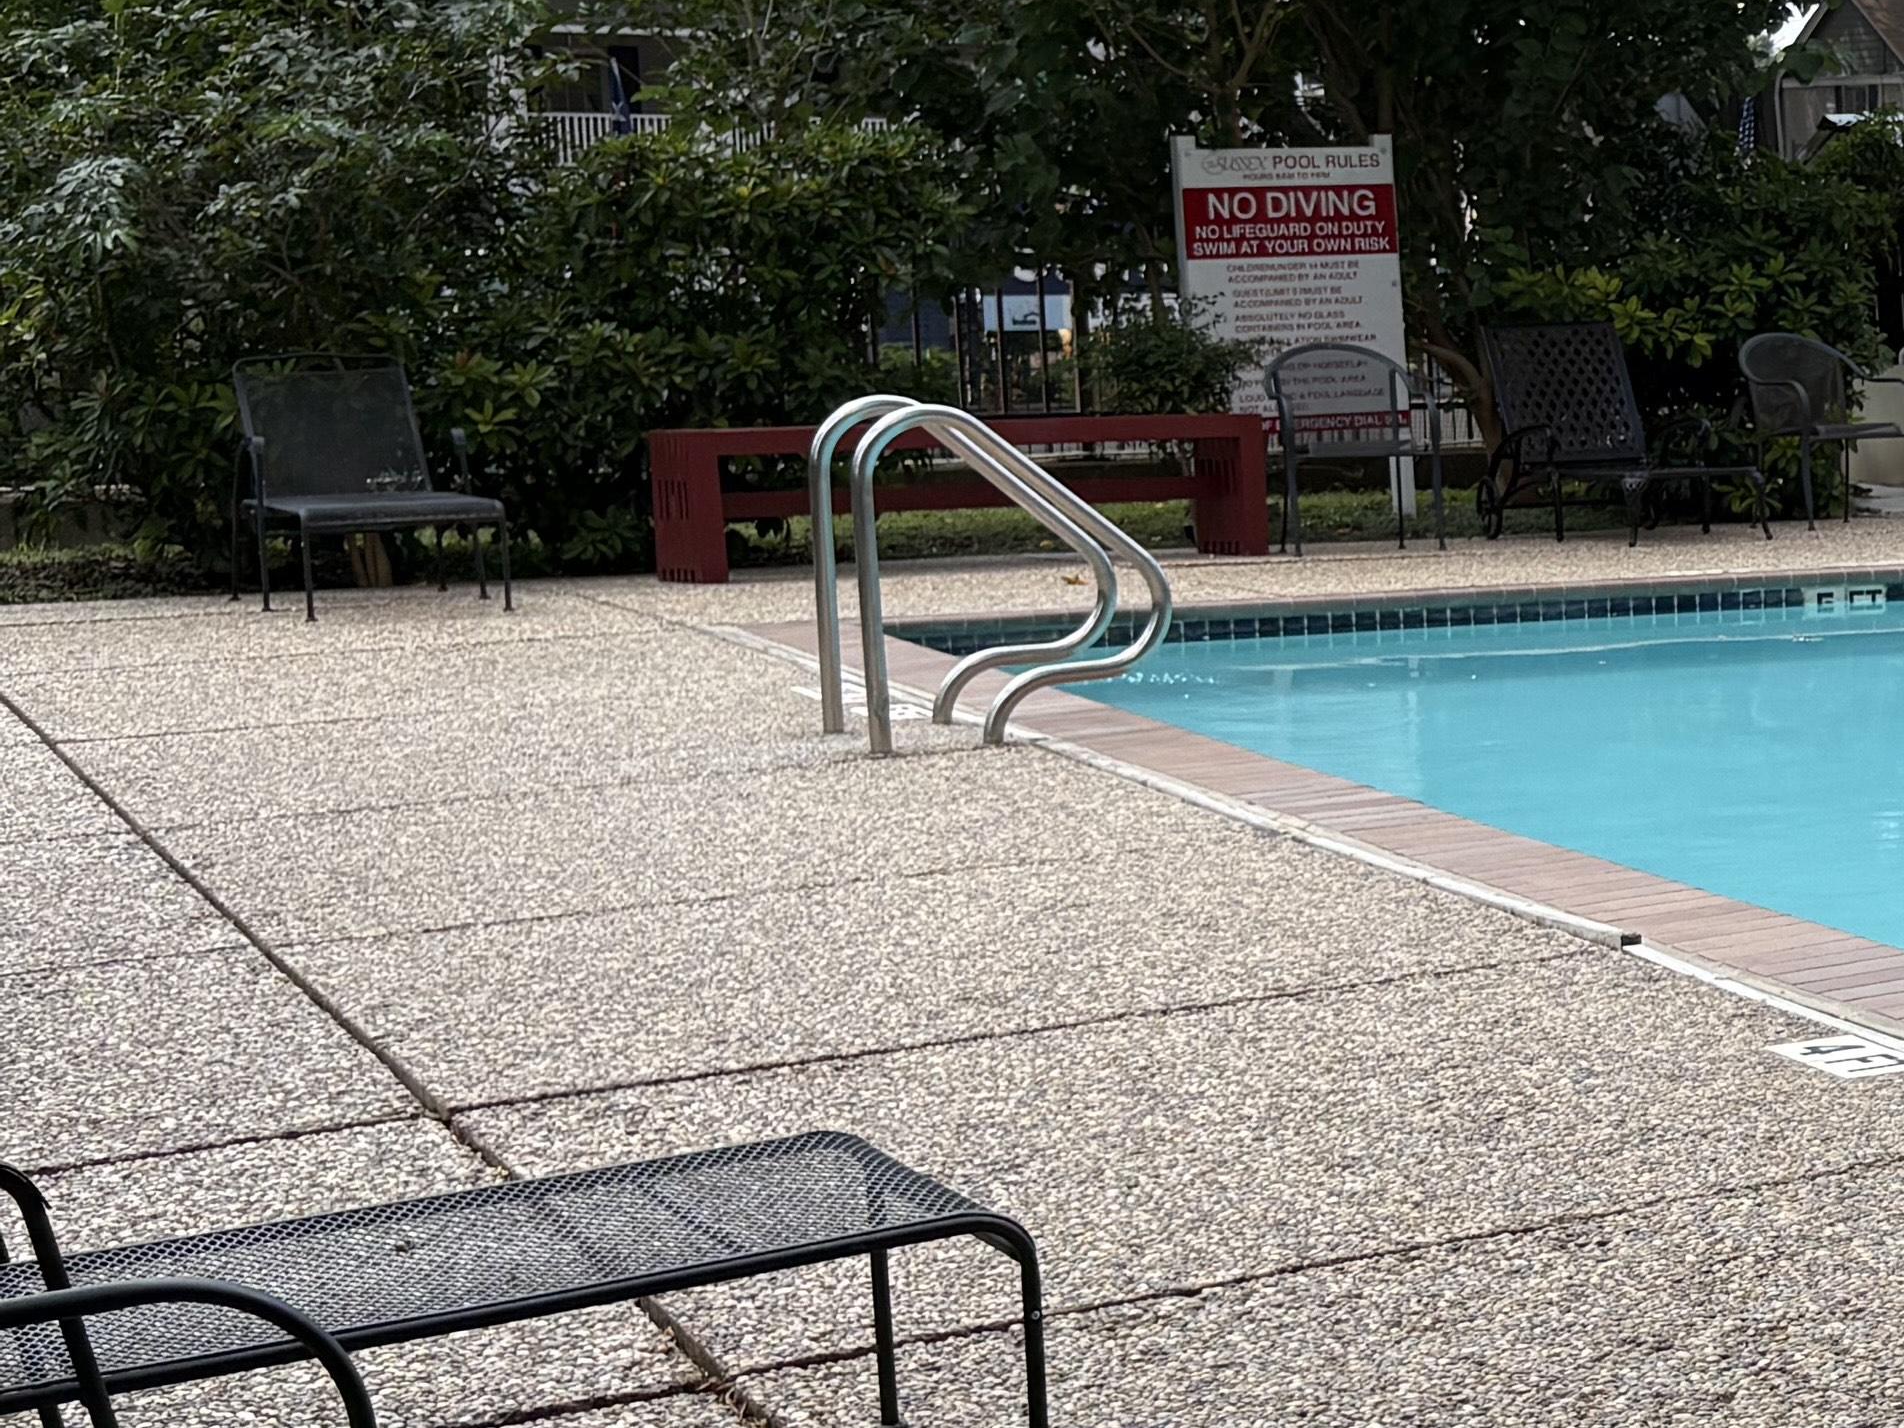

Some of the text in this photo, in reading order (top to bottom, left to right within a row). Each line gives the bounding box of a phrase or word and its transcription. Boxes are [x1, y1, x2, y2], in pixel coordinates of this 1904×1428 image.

[1272, 155, 1321, 170] POOL
[1325, 153, 1380, 169] RULES
[1207, 189, 1376, 220] NO DIVING
[1195, 221, 1385, 239] NO LIFEGUARD ON DUTY
[1193, 236, 1390, 256] SWIM AT YOUR OWN RISK
[1320, 261, 1346, 270] MUST
[1347, 260, 1359, 268] BE
[1228, 271, 1357, 283] ACCOMPANIED BY AN ADULT
[1233, 296, 1363, 309] ACCOMPANIED BY AN ADULT
[1235, 310, 1345, 323] ABSOLUTELY NO GLASS
[1307, 322, 1333, 330] POOL
[1336, 320, 1361, 329] AREA
[1334, 388, 1384, 397] LANGUAGE
[1240, 405, 1259, 414] NOT
[1354, 414, 1382, 426] DIAL
[1800, 1043, 1866, 1056] 4
